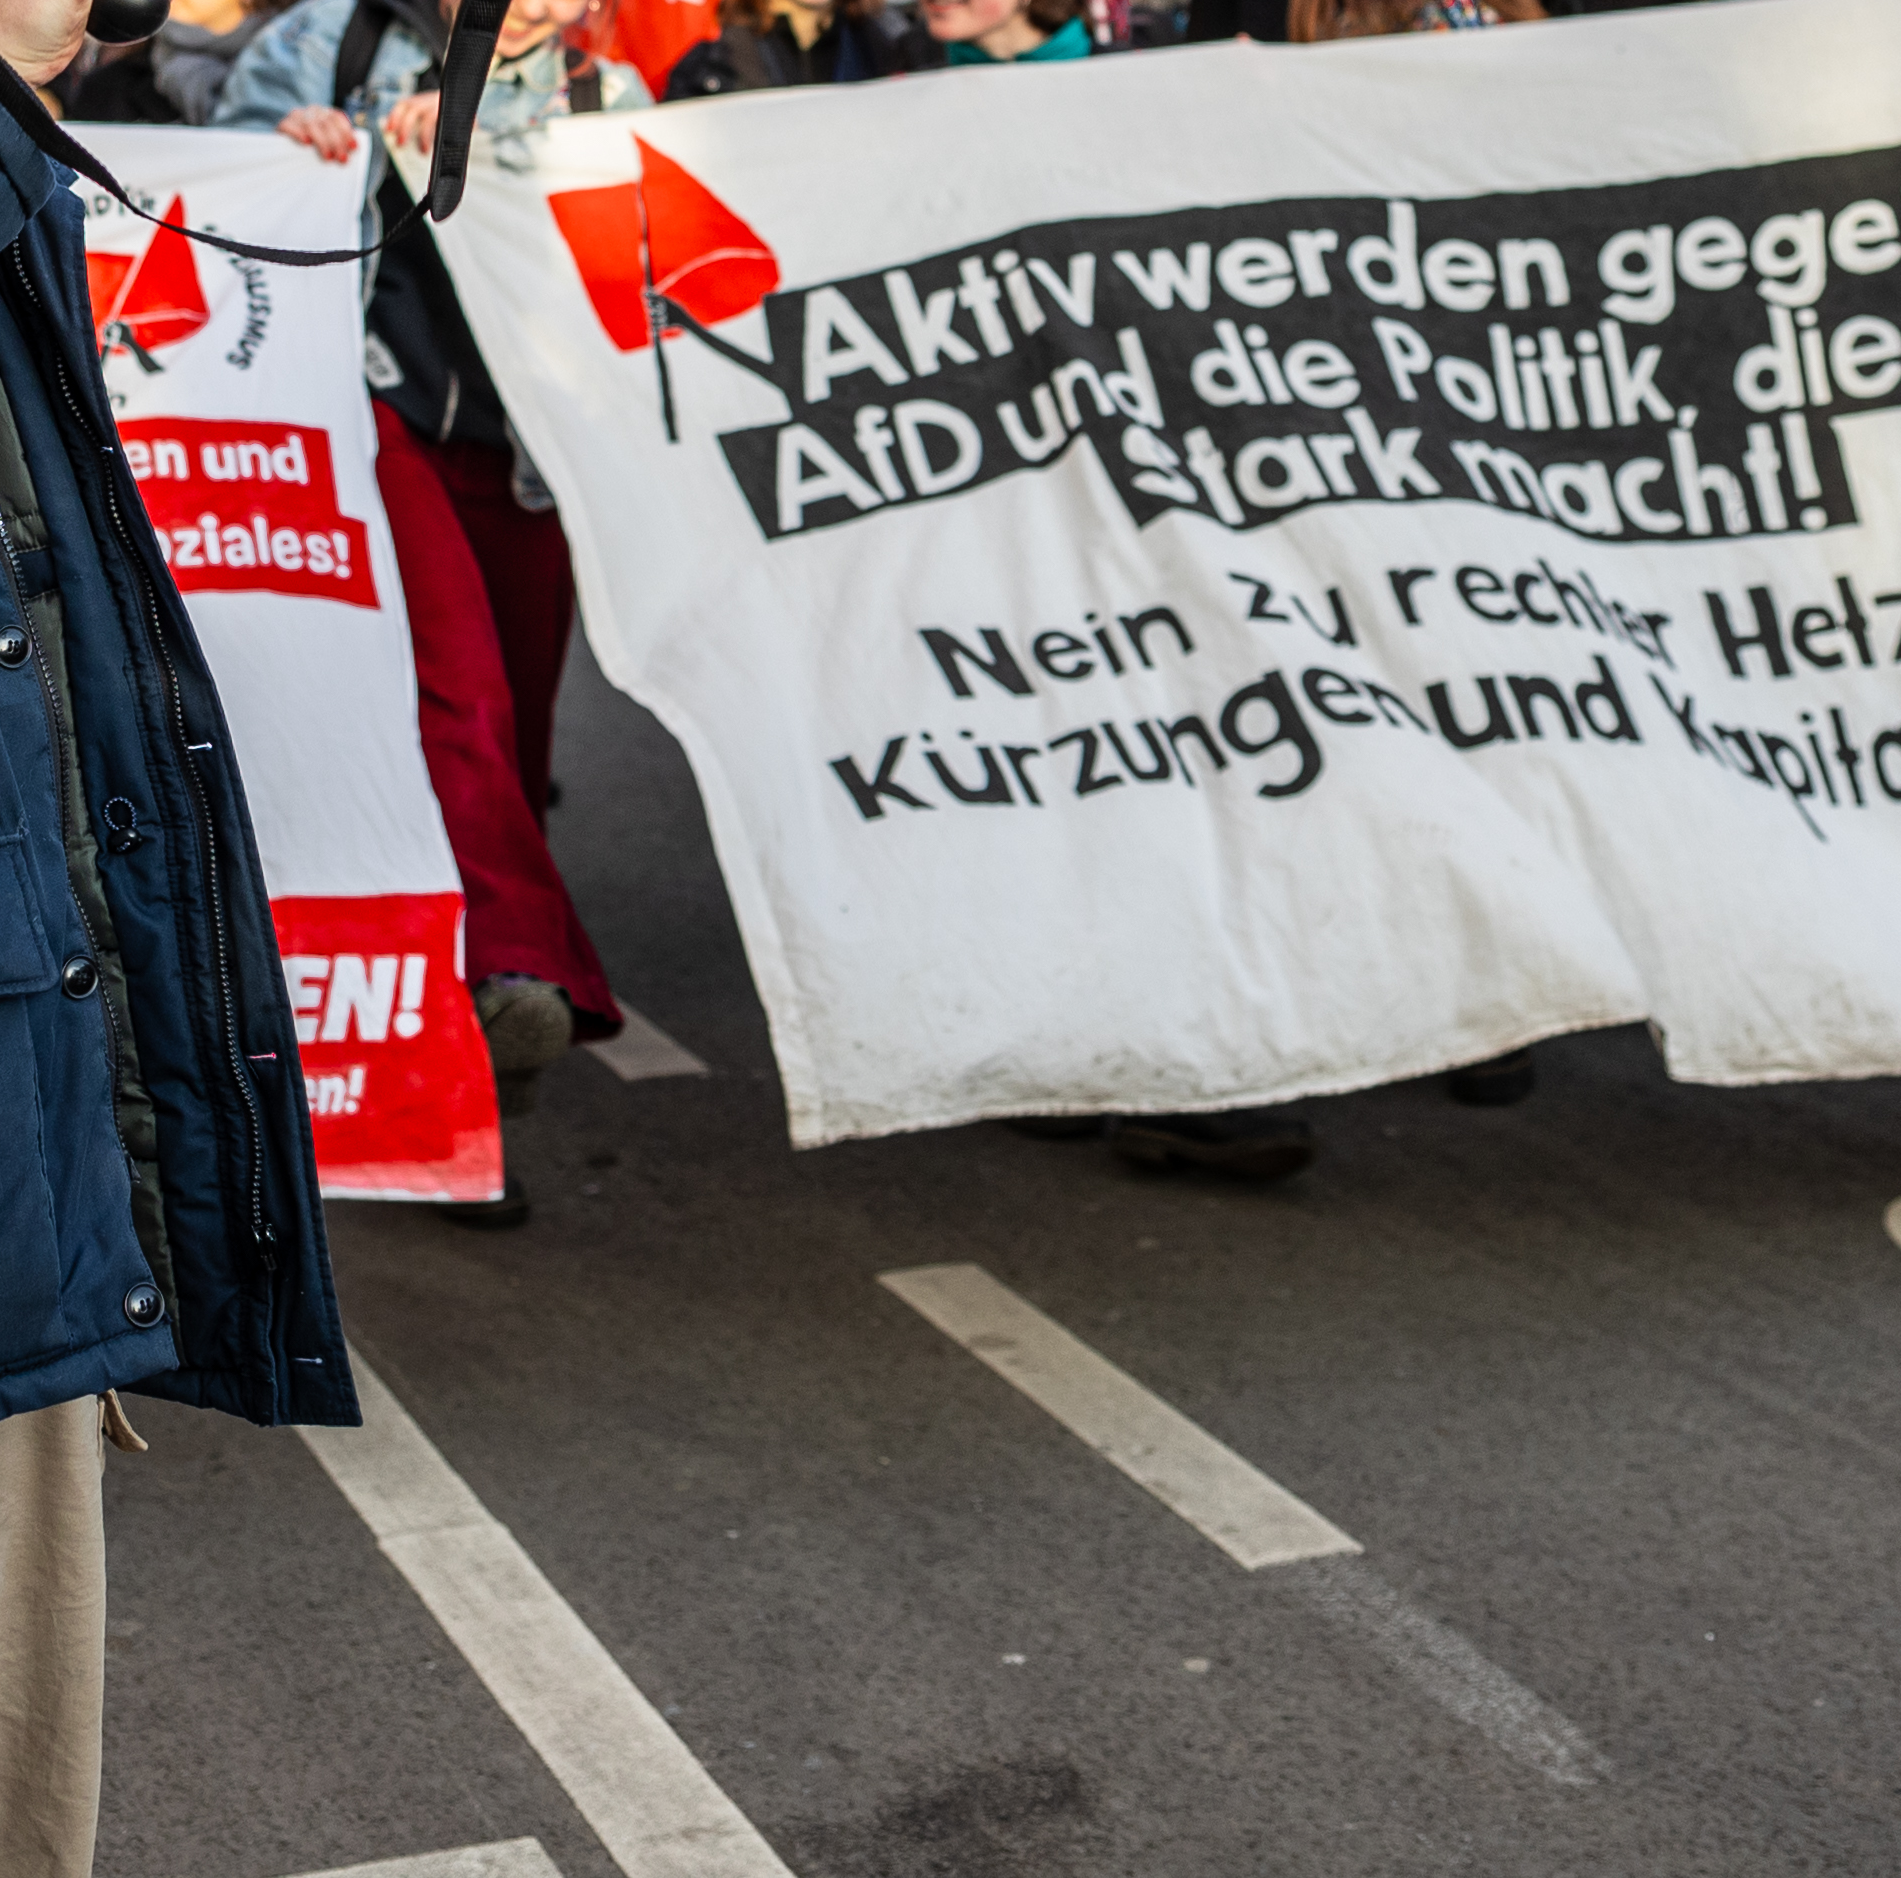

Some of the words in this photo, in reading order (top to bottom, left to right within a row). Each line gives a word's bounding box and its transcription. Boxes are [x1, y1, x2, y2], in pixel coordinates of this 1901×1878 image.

[806, 251, 1096, 403] Aktiv
[1113, 200, 1571, 312] werden
[123, 438, 188, 480] en
[201, 432, 309, 484] und
[776, 401, 982, 531] AfD
[998, 326, 1165, 464] und
[1190, 318, 1361, 408] die
[1372, 316, 1697, 435] Politik,
[1121, 406, 1442, 525] stark
[1452, 412, 1829, 537] macht!
[154, 511, 351, 578] oziales!
[920, 605, 1197, 699] Nein
[1229, 572, 1356, 649] zu
[1388, 558, 1676, 671] rechter
[830, 667, 1429, 821] Kürzungen
[1426, 654, 1643, 751] und
